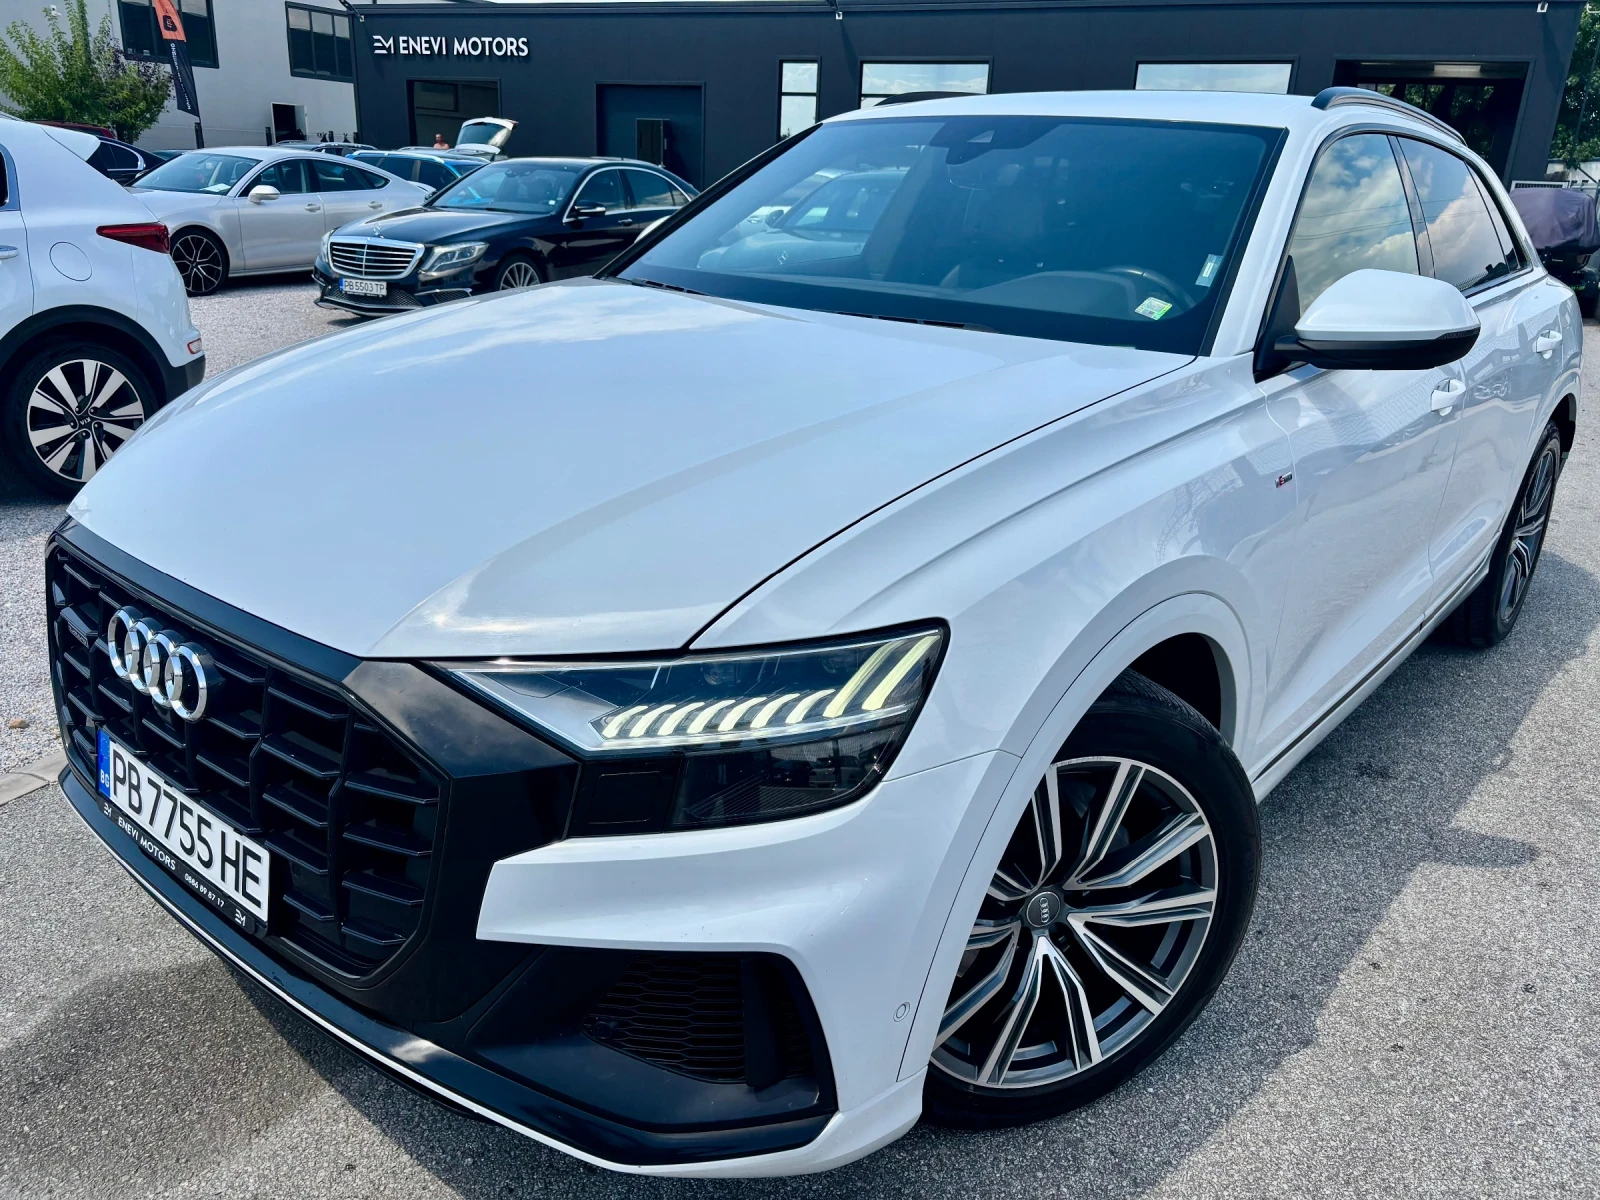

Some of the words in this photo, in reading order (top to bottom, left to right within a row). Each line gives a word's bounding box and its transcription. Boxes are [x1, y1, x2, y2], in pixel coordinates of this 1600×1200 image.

[399, 36, 446, 55] ENEVI
[453, 37, 529, 57] MOTORS
[344, 280, 354, 291] PB
[355, 281, 374, 293] 5503
[375, 283, 385, 293] TP
[100, 768, 110, 788] BG
[113, 748, 142, 815] PB
[147, 776, 214, 870] 7755
[220, 830, 262, 910] HE
[118, 816, 139, 841] ENEVI
[140, 836, 176, 871] MOTORS
[217, 897, 225, 908] 17
